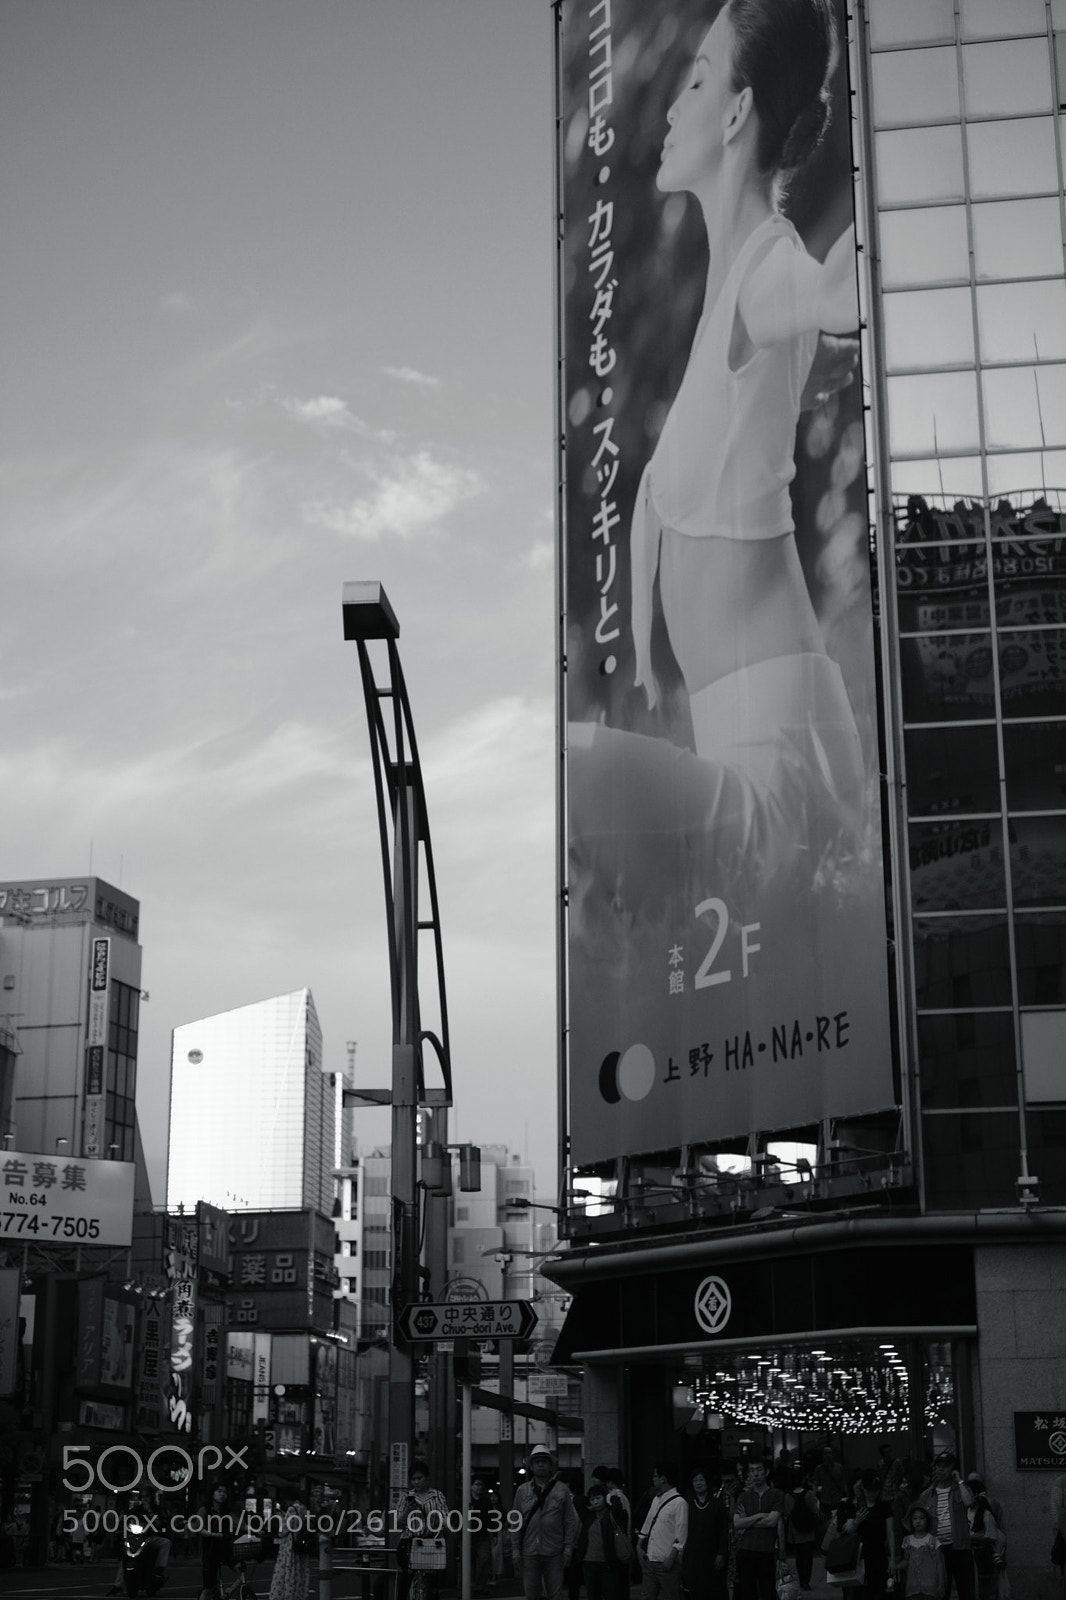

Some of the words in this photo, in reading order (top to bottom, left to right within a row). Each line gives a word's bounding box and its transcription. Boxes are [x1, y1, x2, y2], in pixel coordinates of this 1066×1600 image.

[694, 897, 761, 990] 2F
[668, 943, 685, 995] 本館
[663, 1042, 713, 1083] 上野
[2, 1160, 87, 1192] 告募集
[0, 1212, 100, 1239] 774-7505
[416, 1315, 435, 1329] 437
[444, 1304, 512, 1323] 中央通り
[441, 1321, 492, 1336] Chuo-dori
[495, 1320, 517, 1334] Ave.
[1034, 1415, 1066, 1431] 松坂
